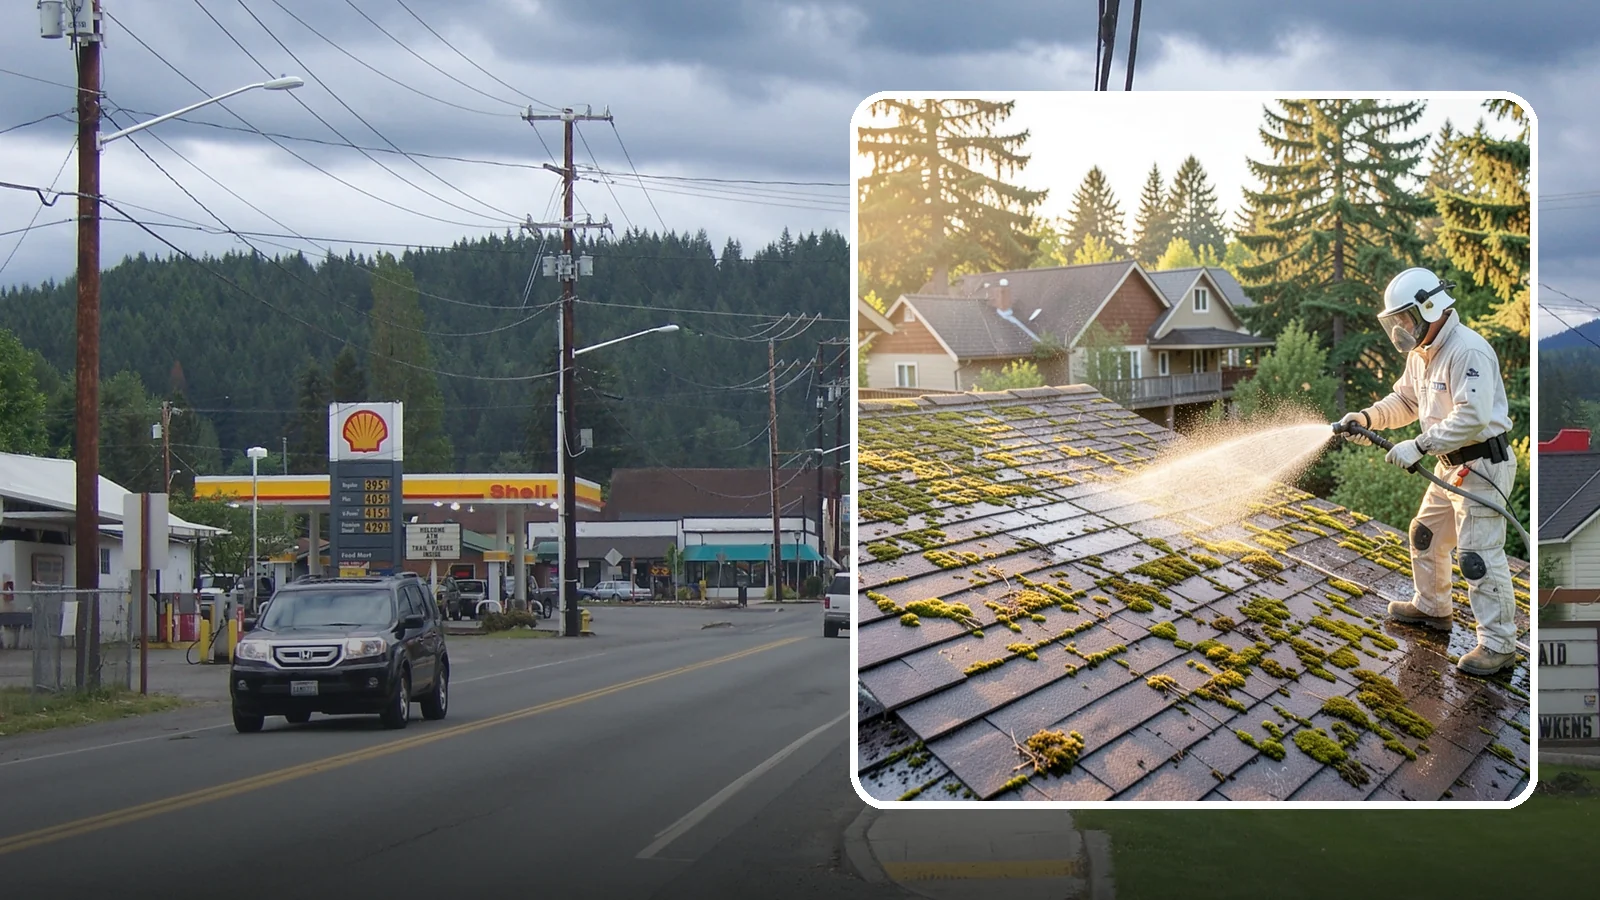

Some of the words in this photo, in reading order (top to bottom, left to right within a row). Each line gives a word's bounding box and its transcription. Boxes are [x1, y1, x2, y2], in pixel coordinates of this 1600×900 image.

[366, 480, 383, 490] 395
[490, 484, 547, 499] Shell
[366, 494, 383, 504] 405
[366, 508, 383, 518] 415
[366, 522, 383, 532] 429
